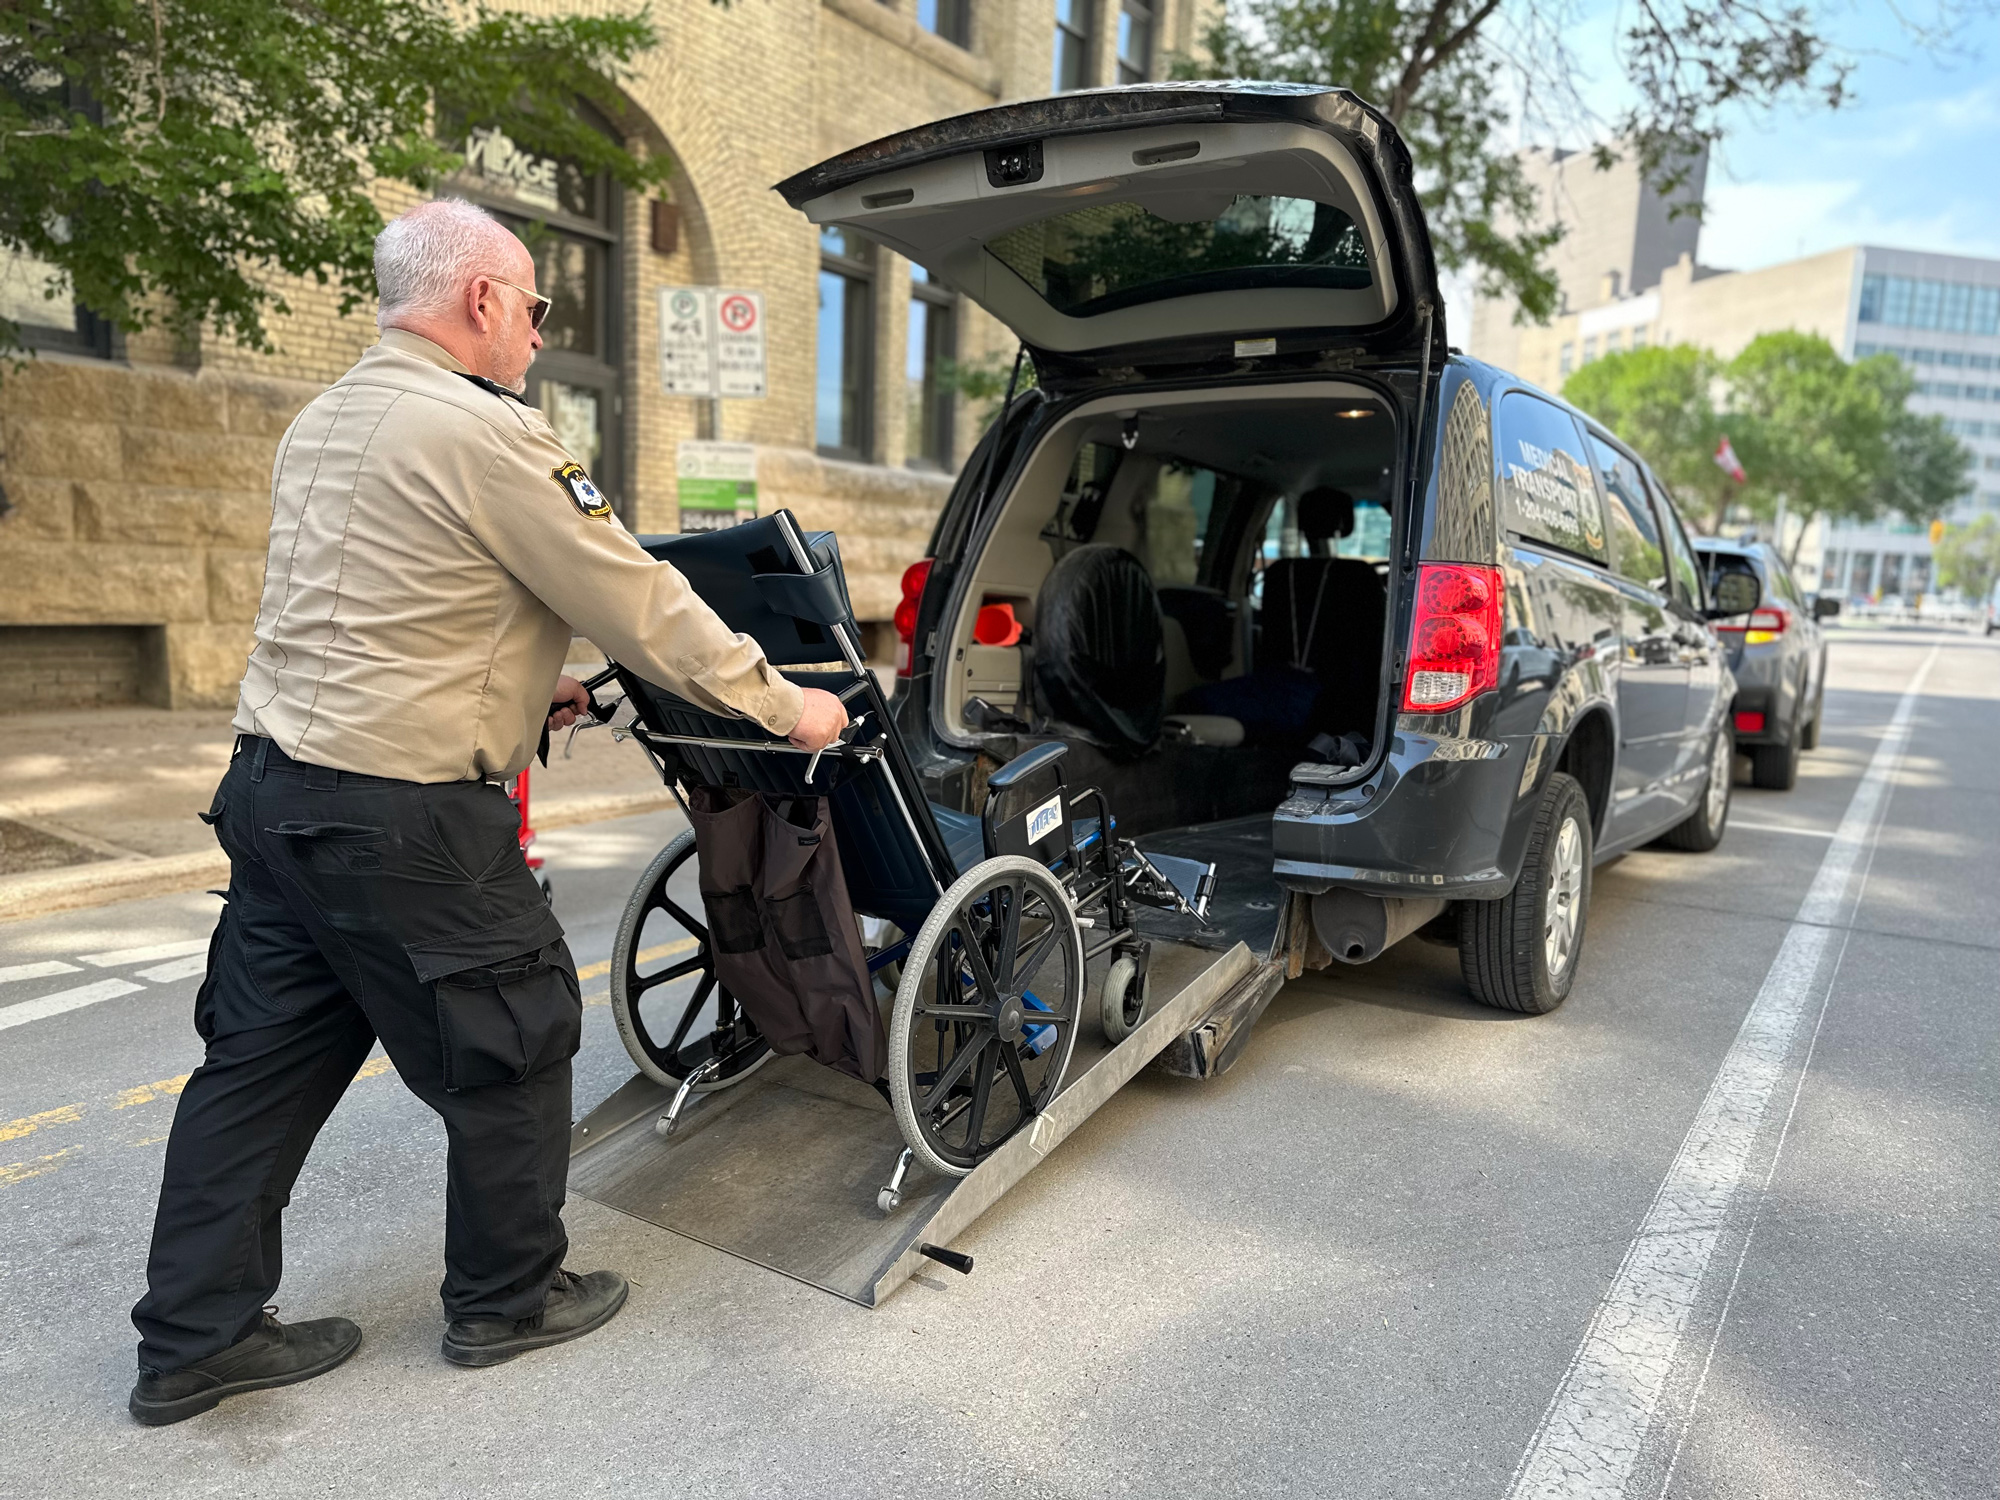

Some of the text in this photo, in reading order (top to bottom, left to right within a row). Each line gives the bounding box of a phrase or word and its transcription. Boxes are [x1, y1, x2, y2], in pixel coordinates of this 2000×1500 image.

[1518, 439, 1572, 482] MEDICAL
[1508, 462, 1579, 512] TRANSPORT
[1028, 803, 1060, 840] TUFFY
